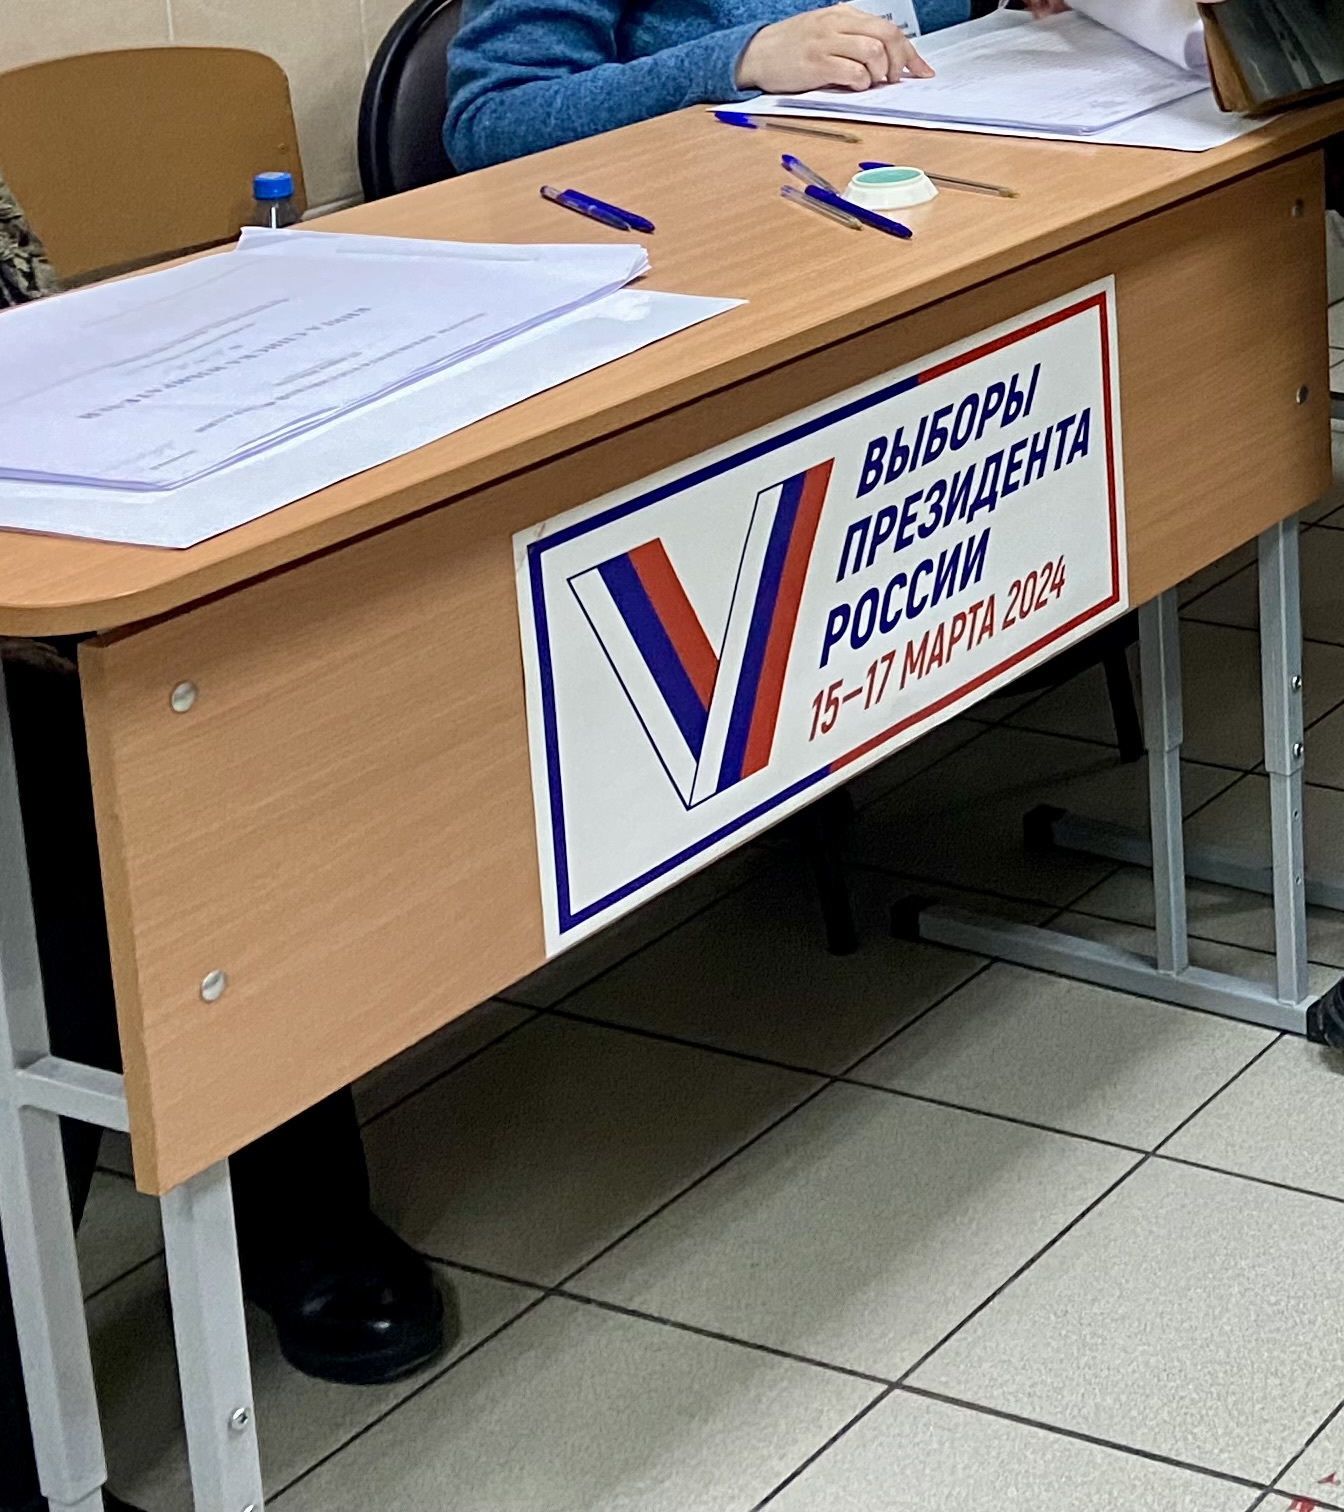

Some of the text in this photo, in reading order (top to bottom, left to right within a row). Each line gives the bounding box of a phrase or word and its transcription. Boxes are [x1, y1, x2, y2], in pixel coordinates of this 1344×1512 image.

[836, 407, 1091, 583] ПРЕЗИДЕНТА
[856, 363, 1041, 499] ВЫБОРЫ
[819, 527, 991, 669] РОССИИ
[899, 593, 995, 690] МАРТА
[1001, 554, 1066, 631] 2024
